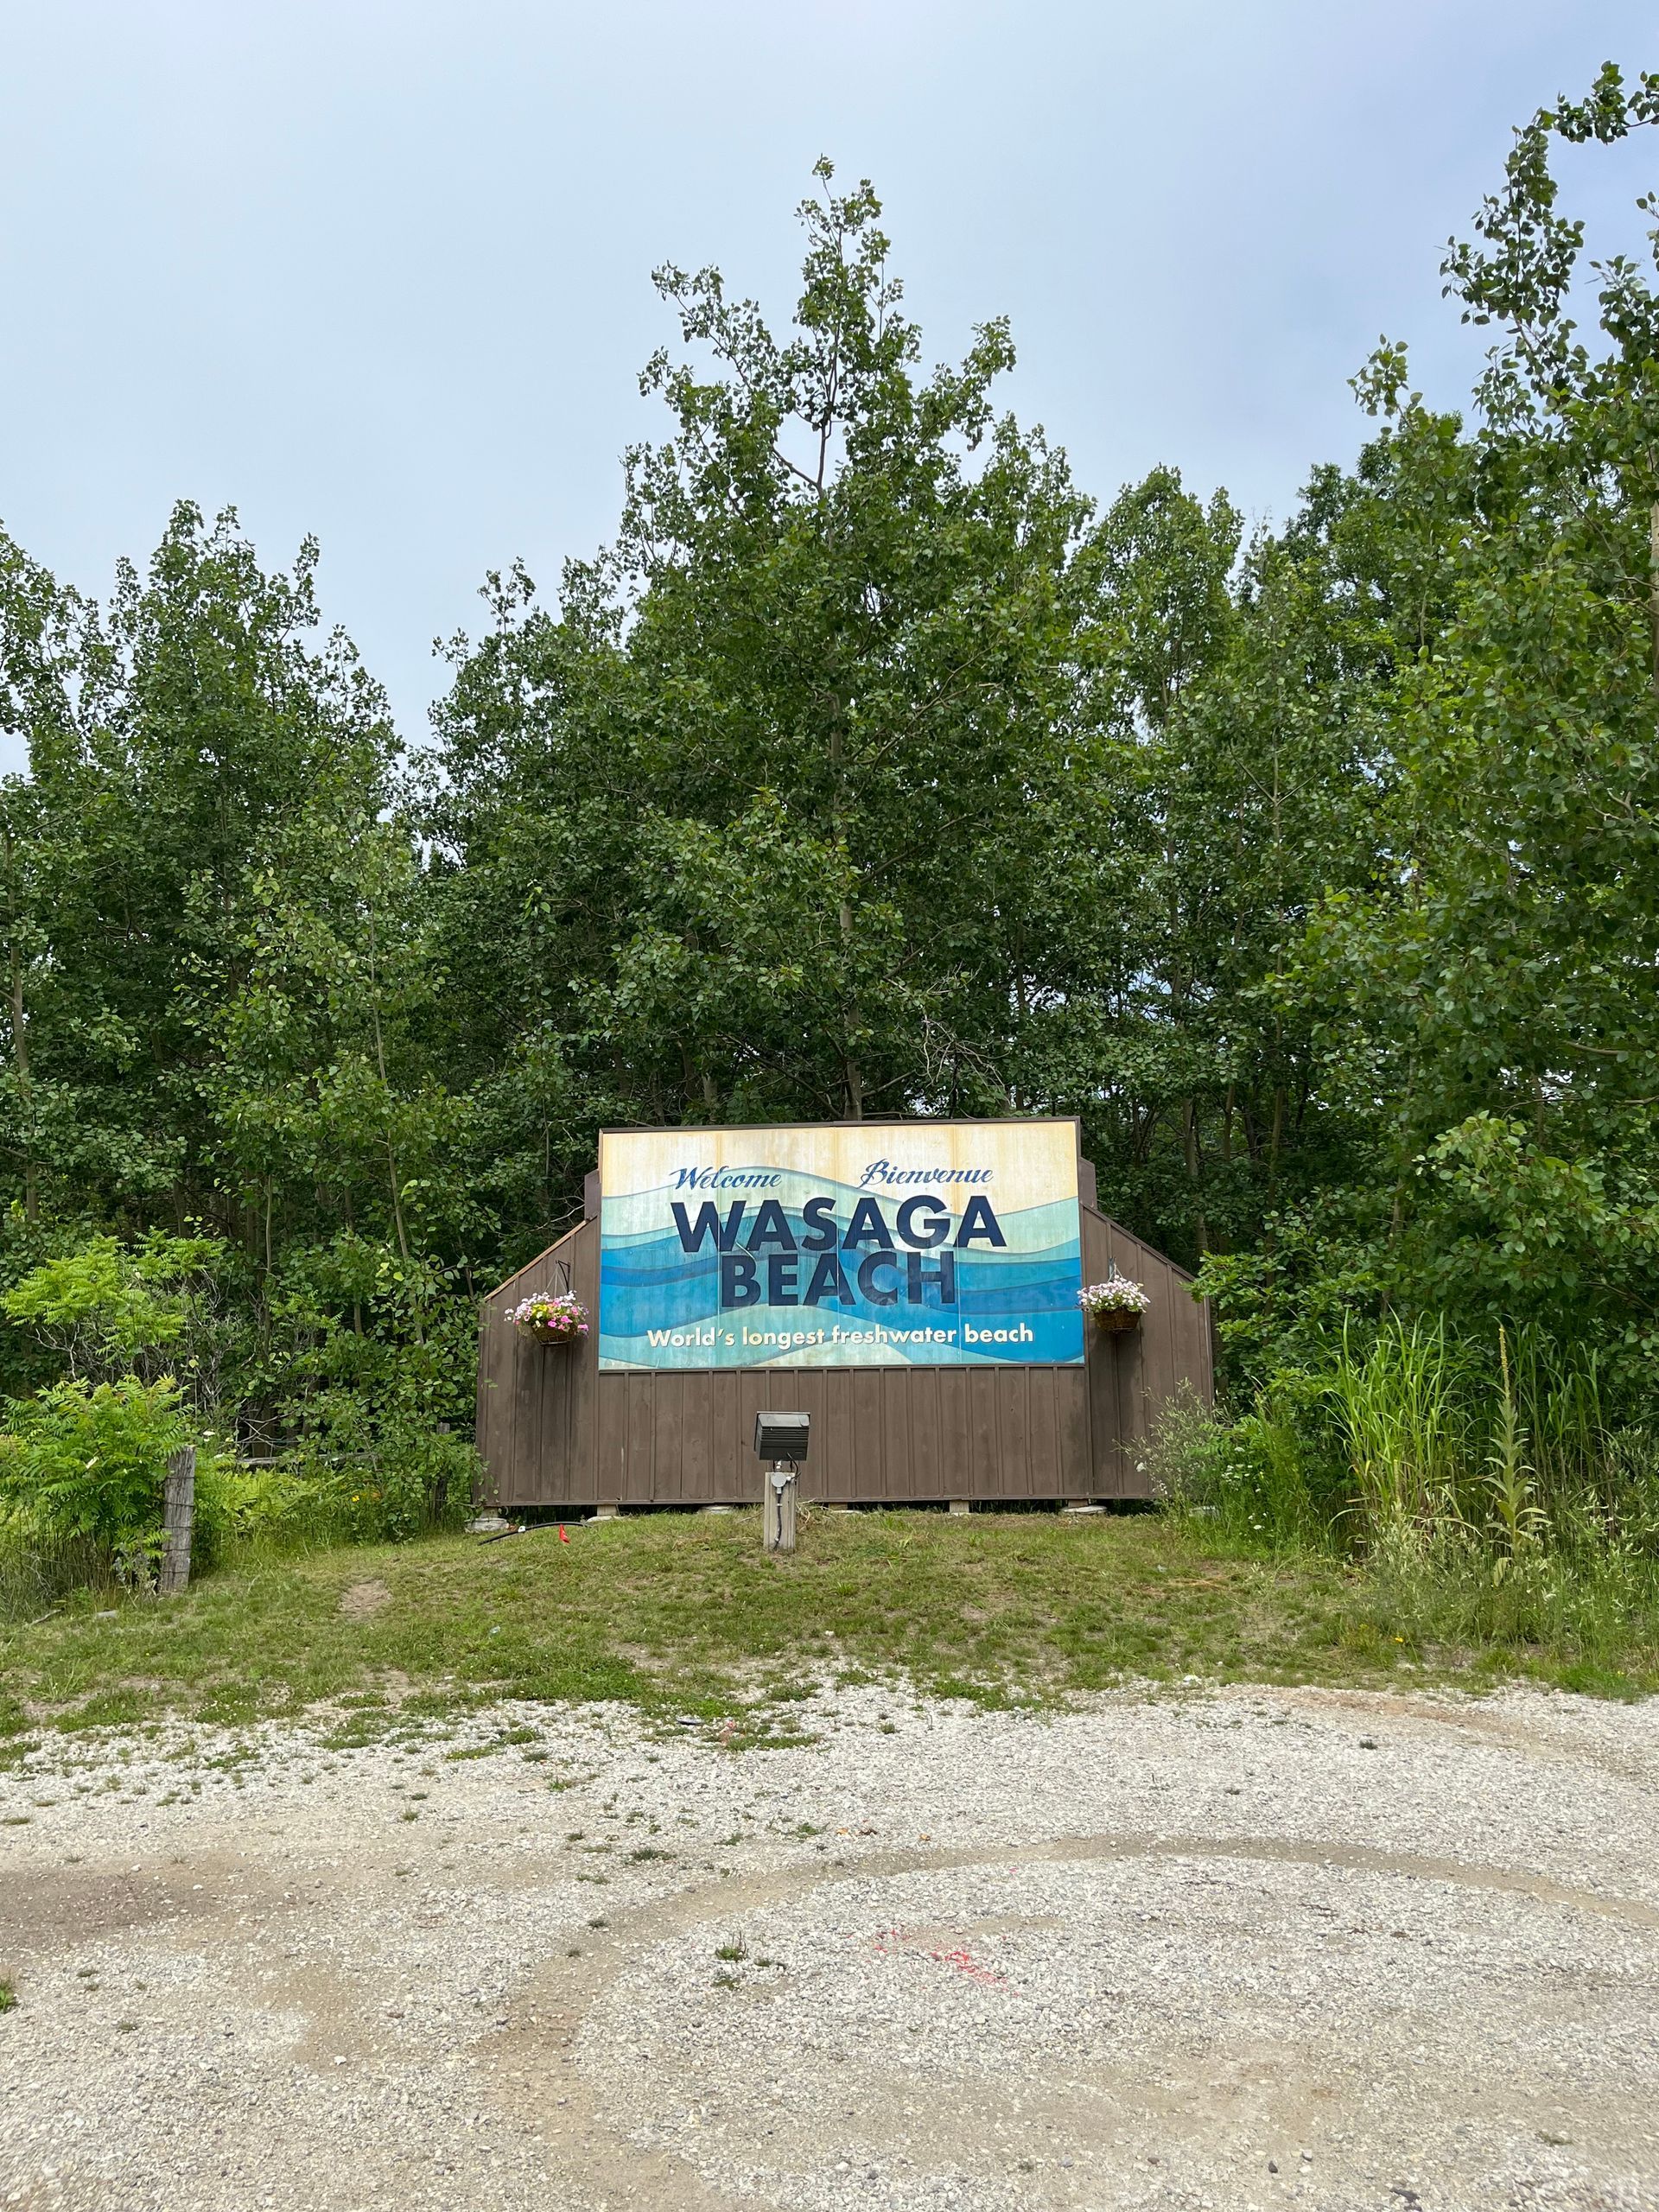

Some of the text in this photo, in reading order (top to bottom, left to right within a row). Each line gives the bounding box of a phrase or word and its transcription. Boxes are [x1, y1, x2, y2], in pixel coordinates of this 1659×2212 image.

[670, 1166, 783, 1190] Welcome
[859, 1158, 995, 1190] Bienvenue
[671, 1195, 1007, 1253] WASAGA
[721, 1251, 956, 1307] BEACH
[647, 1323, 1034, 1351] World's longest freshwater beach
